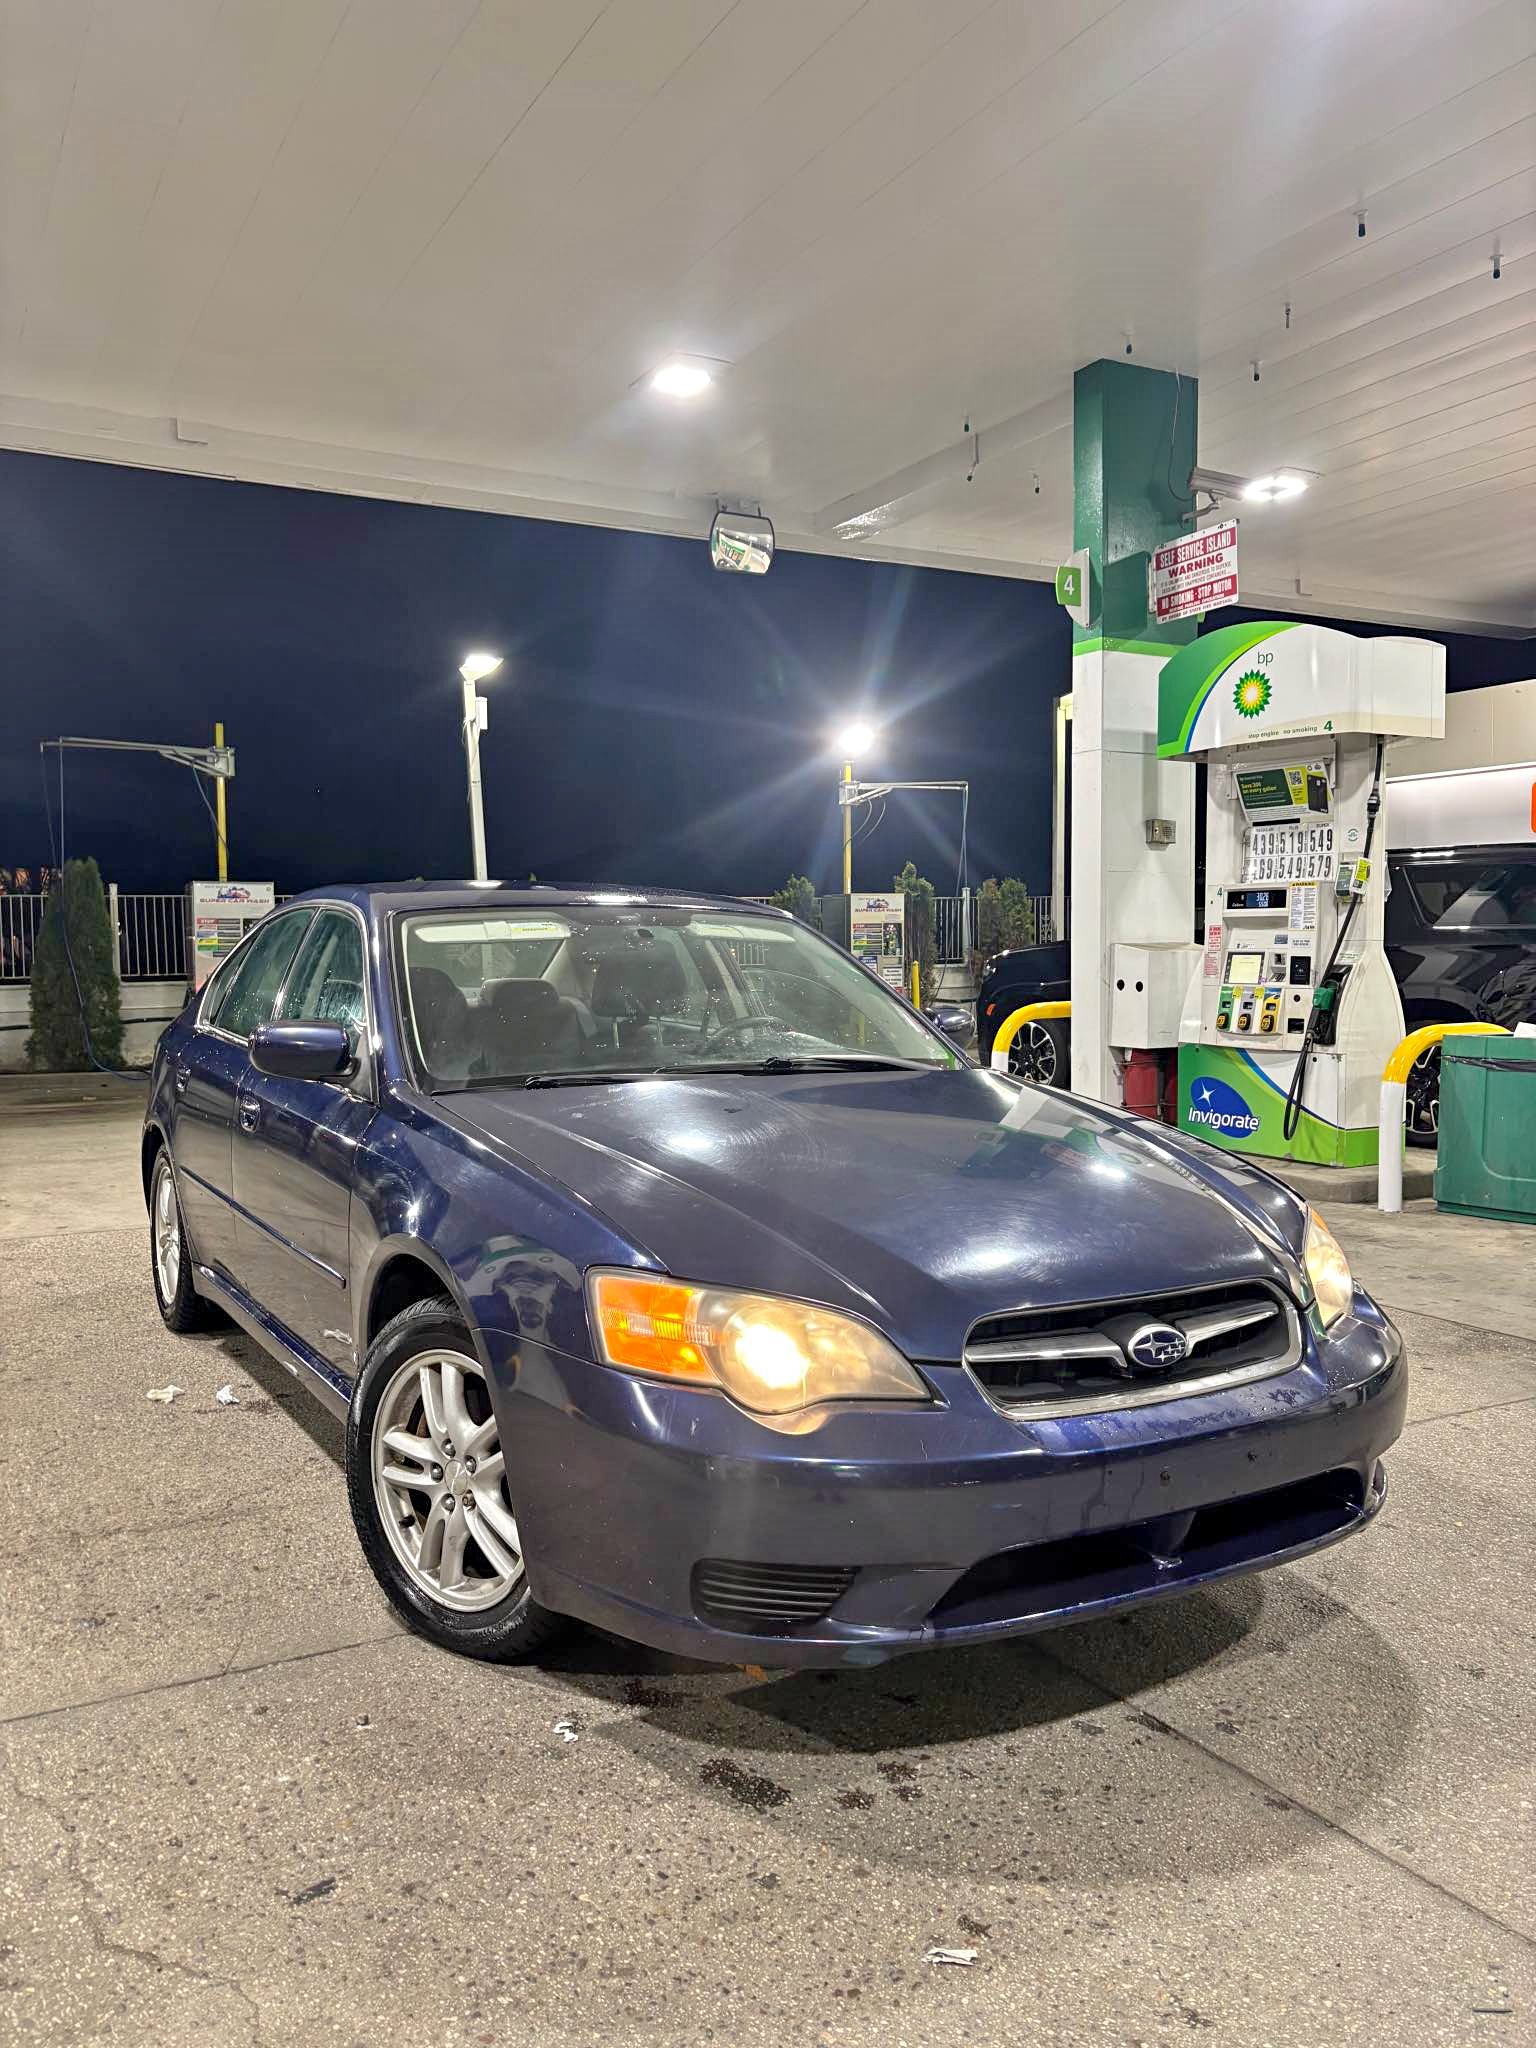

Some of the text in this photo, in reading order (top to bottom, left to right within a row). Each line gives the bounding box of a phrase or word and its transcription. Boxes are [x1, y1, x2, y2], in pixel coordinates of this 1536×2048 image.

[1160, 531, 1231, 568] SELF SERVICE ISLAND
[1168, 553, 1224, 578] WARNING
[1063, 574, 1075, 596] 4
[1161, 578, 1232, 609] NO SMOKING STOP MOTOR
[1257, 652, 1274, 666] bp
[1260, 730, 1279, 738] engine
[1292, 725, 1318, 734] smoking
[1323, 720, 1333, 731] 4
[1252, 833, 1275, 856] 4.39
[1280, 831, 1304, 855] 5.19
[1309, 828, 1333, 852] 5.49
[1278, 856, 1303, 879] 5.49
[1308, 854, 1332, 878] 5.79
[1217, 887, 1222, 896] 4
[1188, 1107, 1259, 1130] Invigorate
